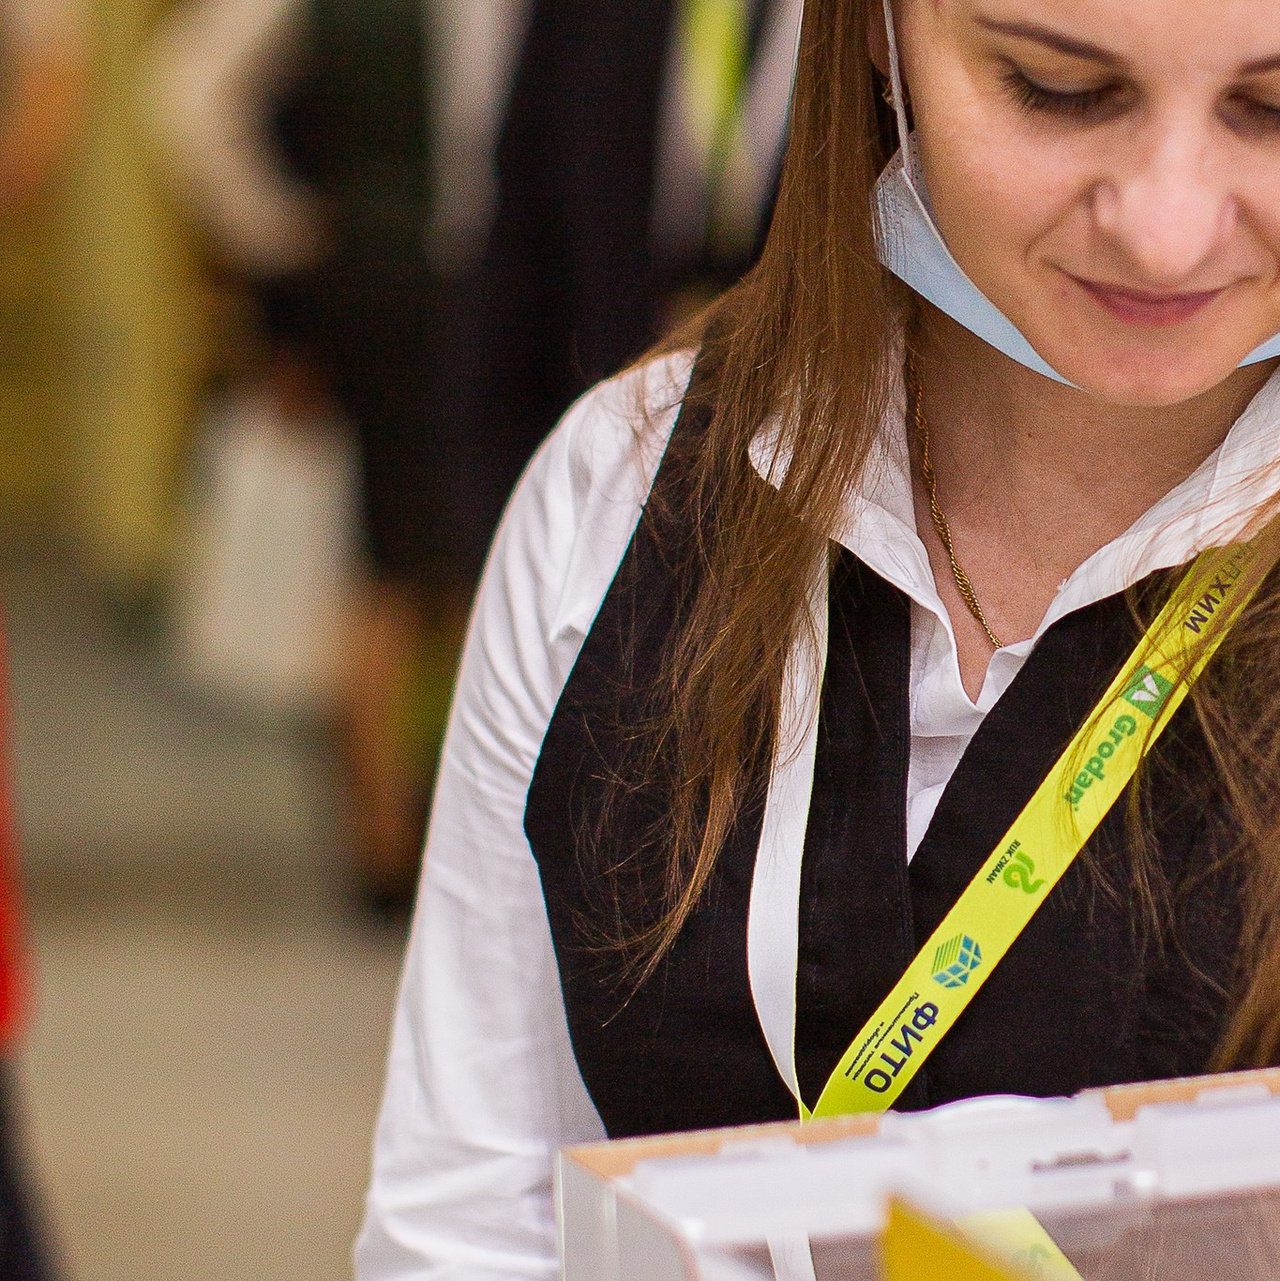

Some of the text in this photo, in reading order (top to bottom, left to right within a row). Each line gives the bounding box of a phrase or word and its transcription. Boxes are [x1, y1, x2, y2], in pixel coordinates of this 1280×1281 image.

[1063, 715, 1137, 805] Grodan
[986, 839, 1021, 884] RIJK ZWAAN
[864, 1002, 939, 1093] ФИТО
